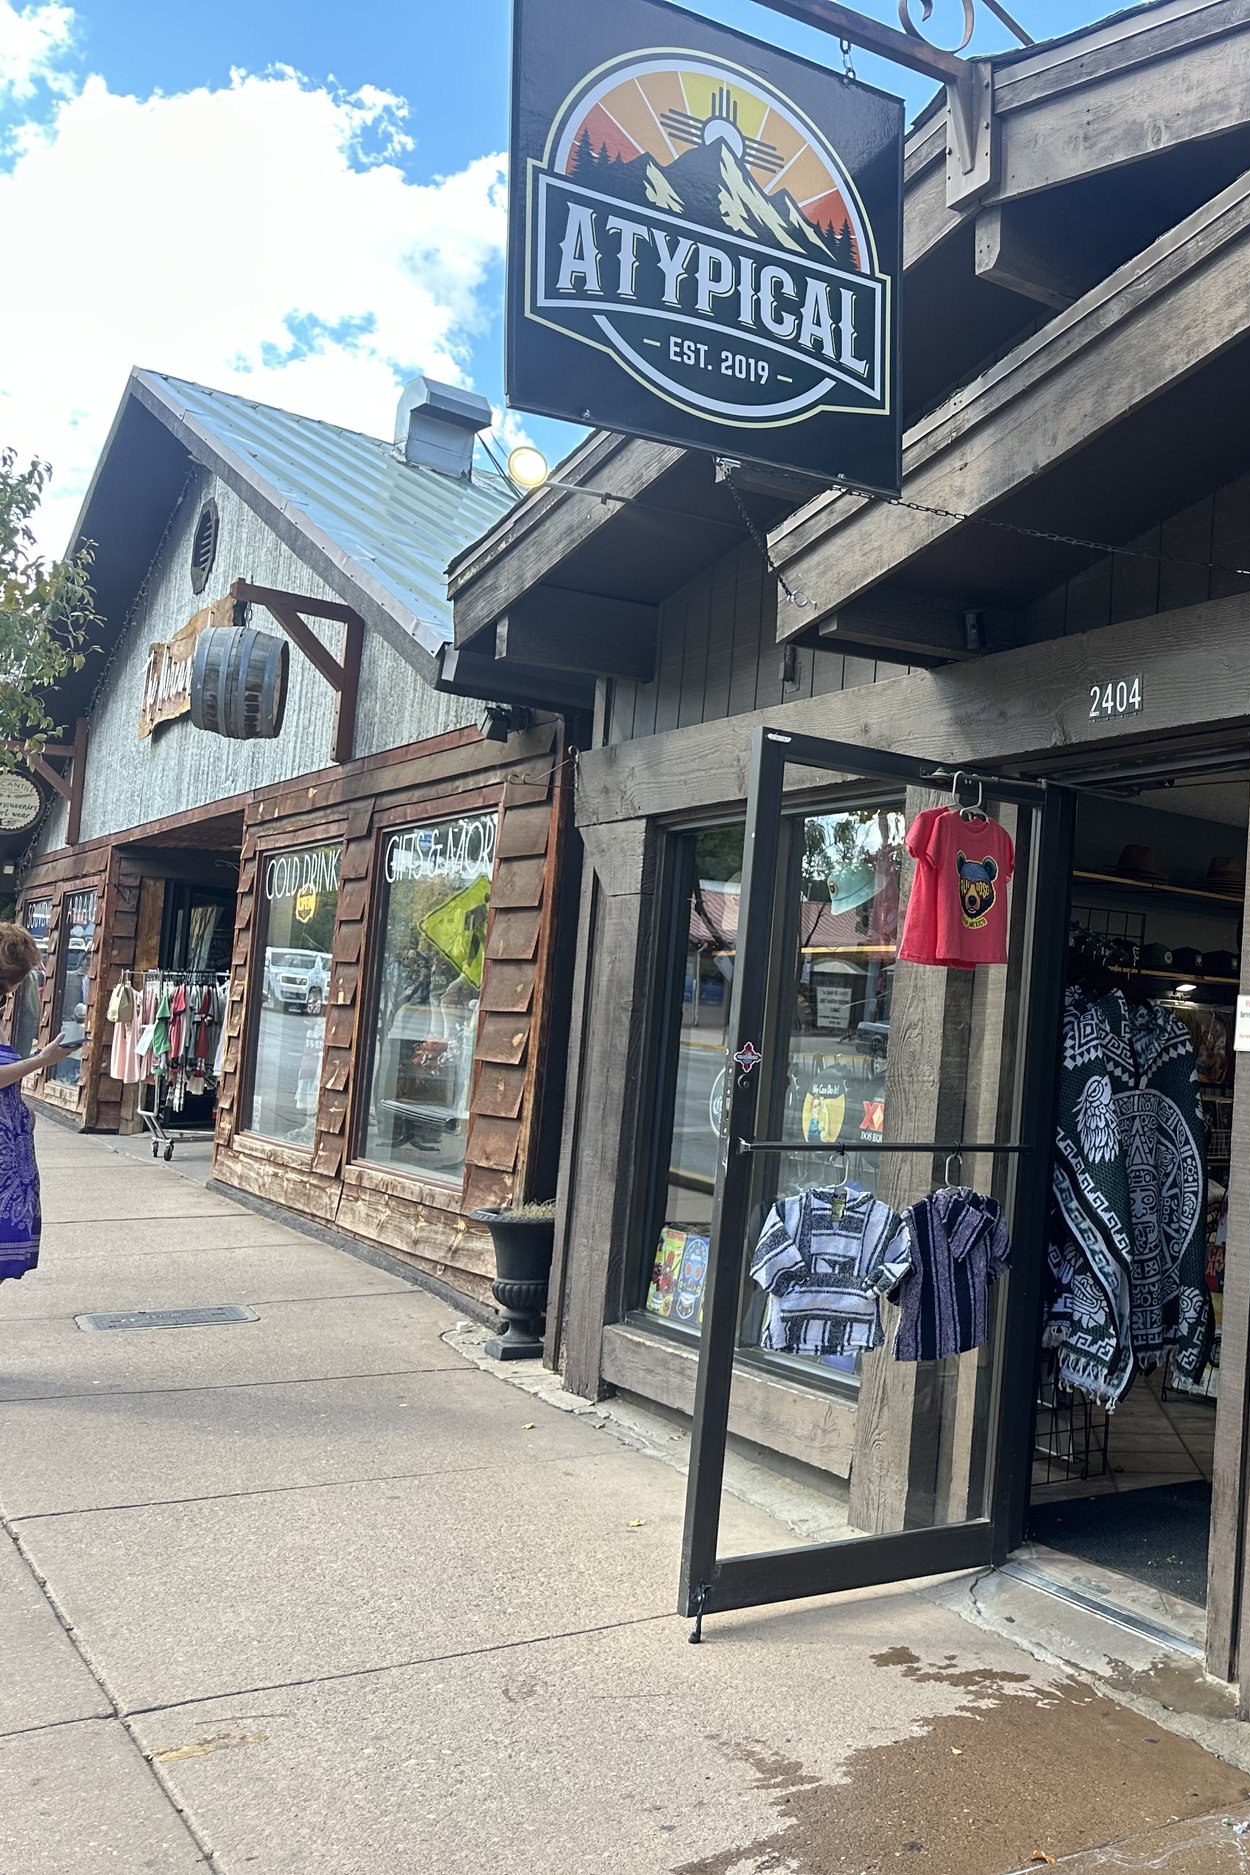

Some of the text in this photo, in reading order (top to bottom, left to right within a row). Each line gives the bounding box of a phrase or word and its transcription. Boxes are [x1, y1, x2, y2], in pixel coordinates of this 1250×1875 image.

[555, 201, 869, 378] ATYPICAL
[669, 335, 770, 385] EST. 2019
[1089, 678, 1141, 717] 2404
[266, 856, 300, 900] COLD
[385, 831, 424, 884] GIFTS
